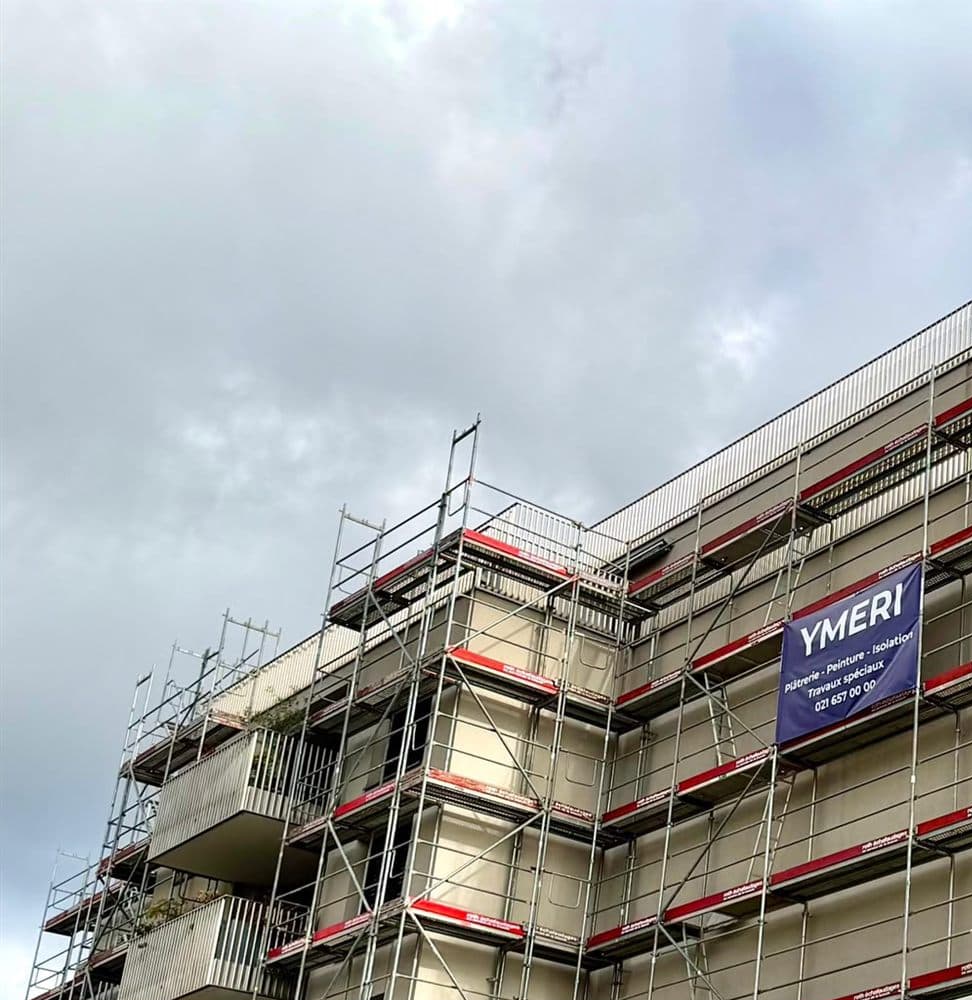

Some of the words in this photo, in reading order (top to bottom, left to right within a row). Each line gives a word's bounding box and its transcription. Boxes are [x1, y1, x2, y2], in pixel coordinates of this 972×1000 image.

[800, 583, 903, 656] YMERI
[784, 671, 820, 694] Plâtrerie
[827, 651, 865, 675] Peinture
[872, 631, 914, 655] Isolation
[808, 678, 842, 699] Travaux
[843, 660, 885, 685] spéciaux
[815, 699, 829, 712] 021
[830, 691, 847, 706] 657
[849, 685, 862, 698] 00
[863, 679, 876, 692] 00
